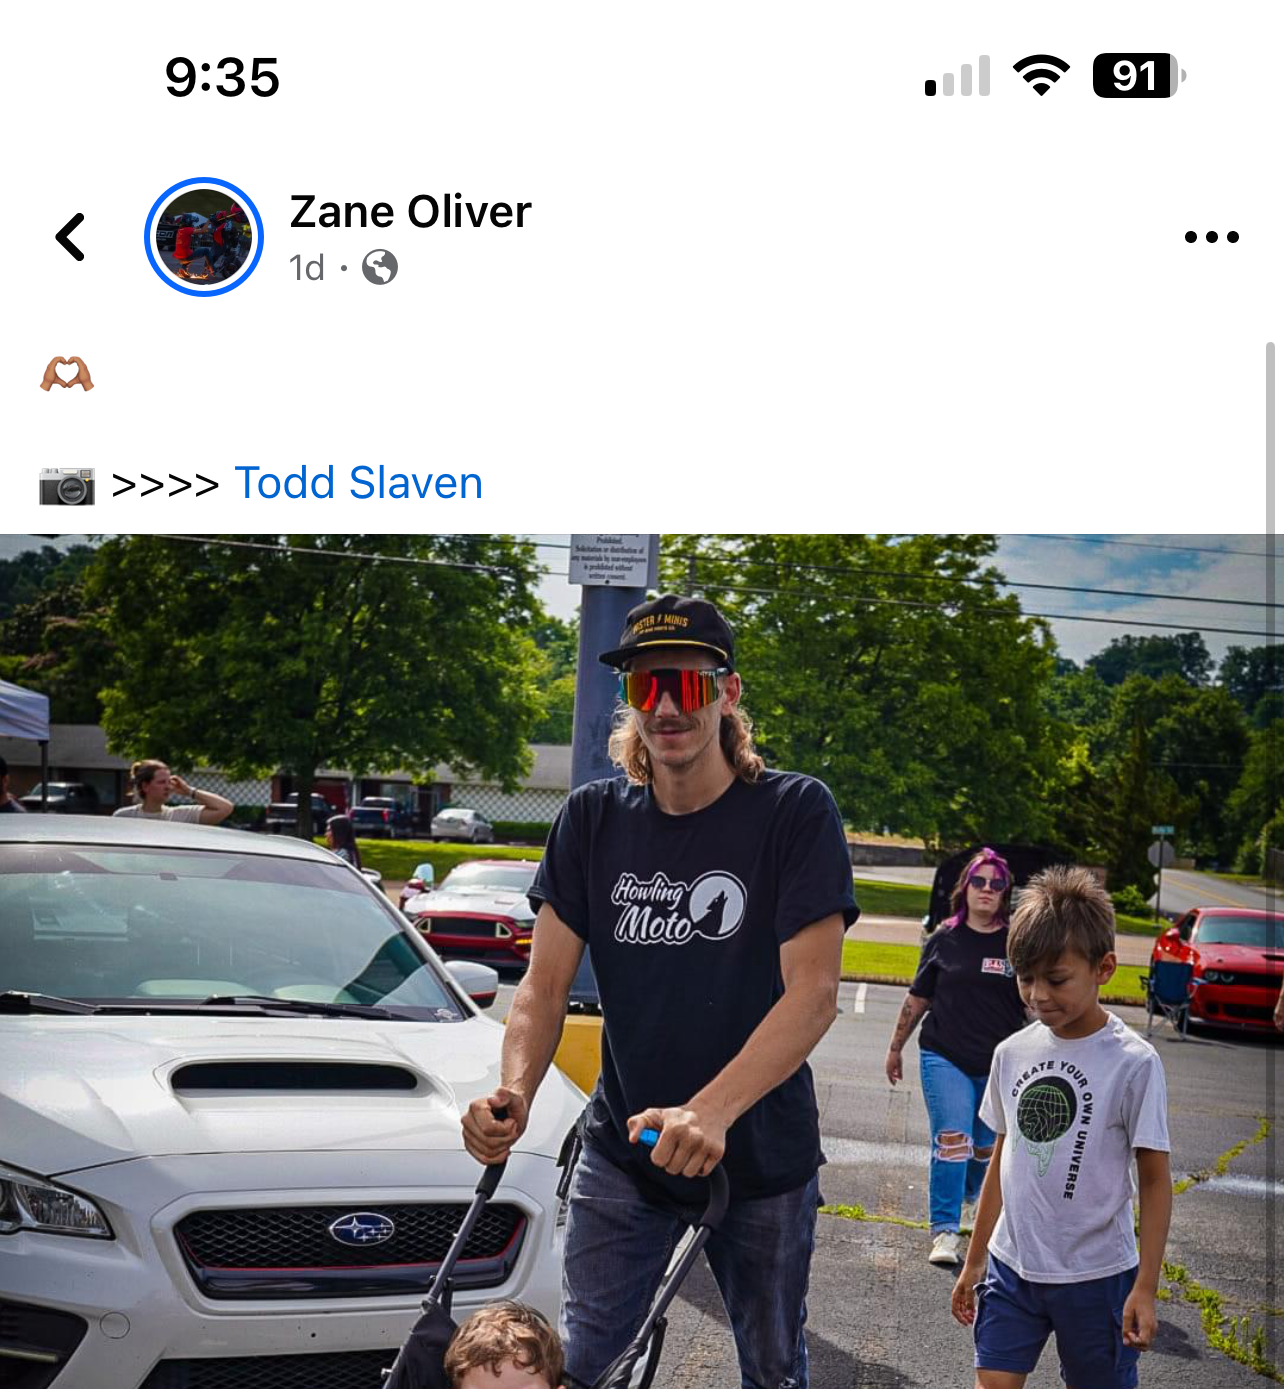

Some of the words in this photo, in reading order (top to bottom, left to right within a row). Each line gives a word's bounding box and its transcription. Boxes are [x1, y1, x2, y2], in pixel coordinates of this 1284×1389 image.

[613, 876, 684, 911] Howling
[617, 905, 692, 940] Moto
[1011, 1060, 1055, 1097] CREATE
[1059, 1060, 1089, 1089] YOUR
[1079, 1092, 1094, 1126] OWN
[1063, 1131, 1088, 1200] UNIVERSE
